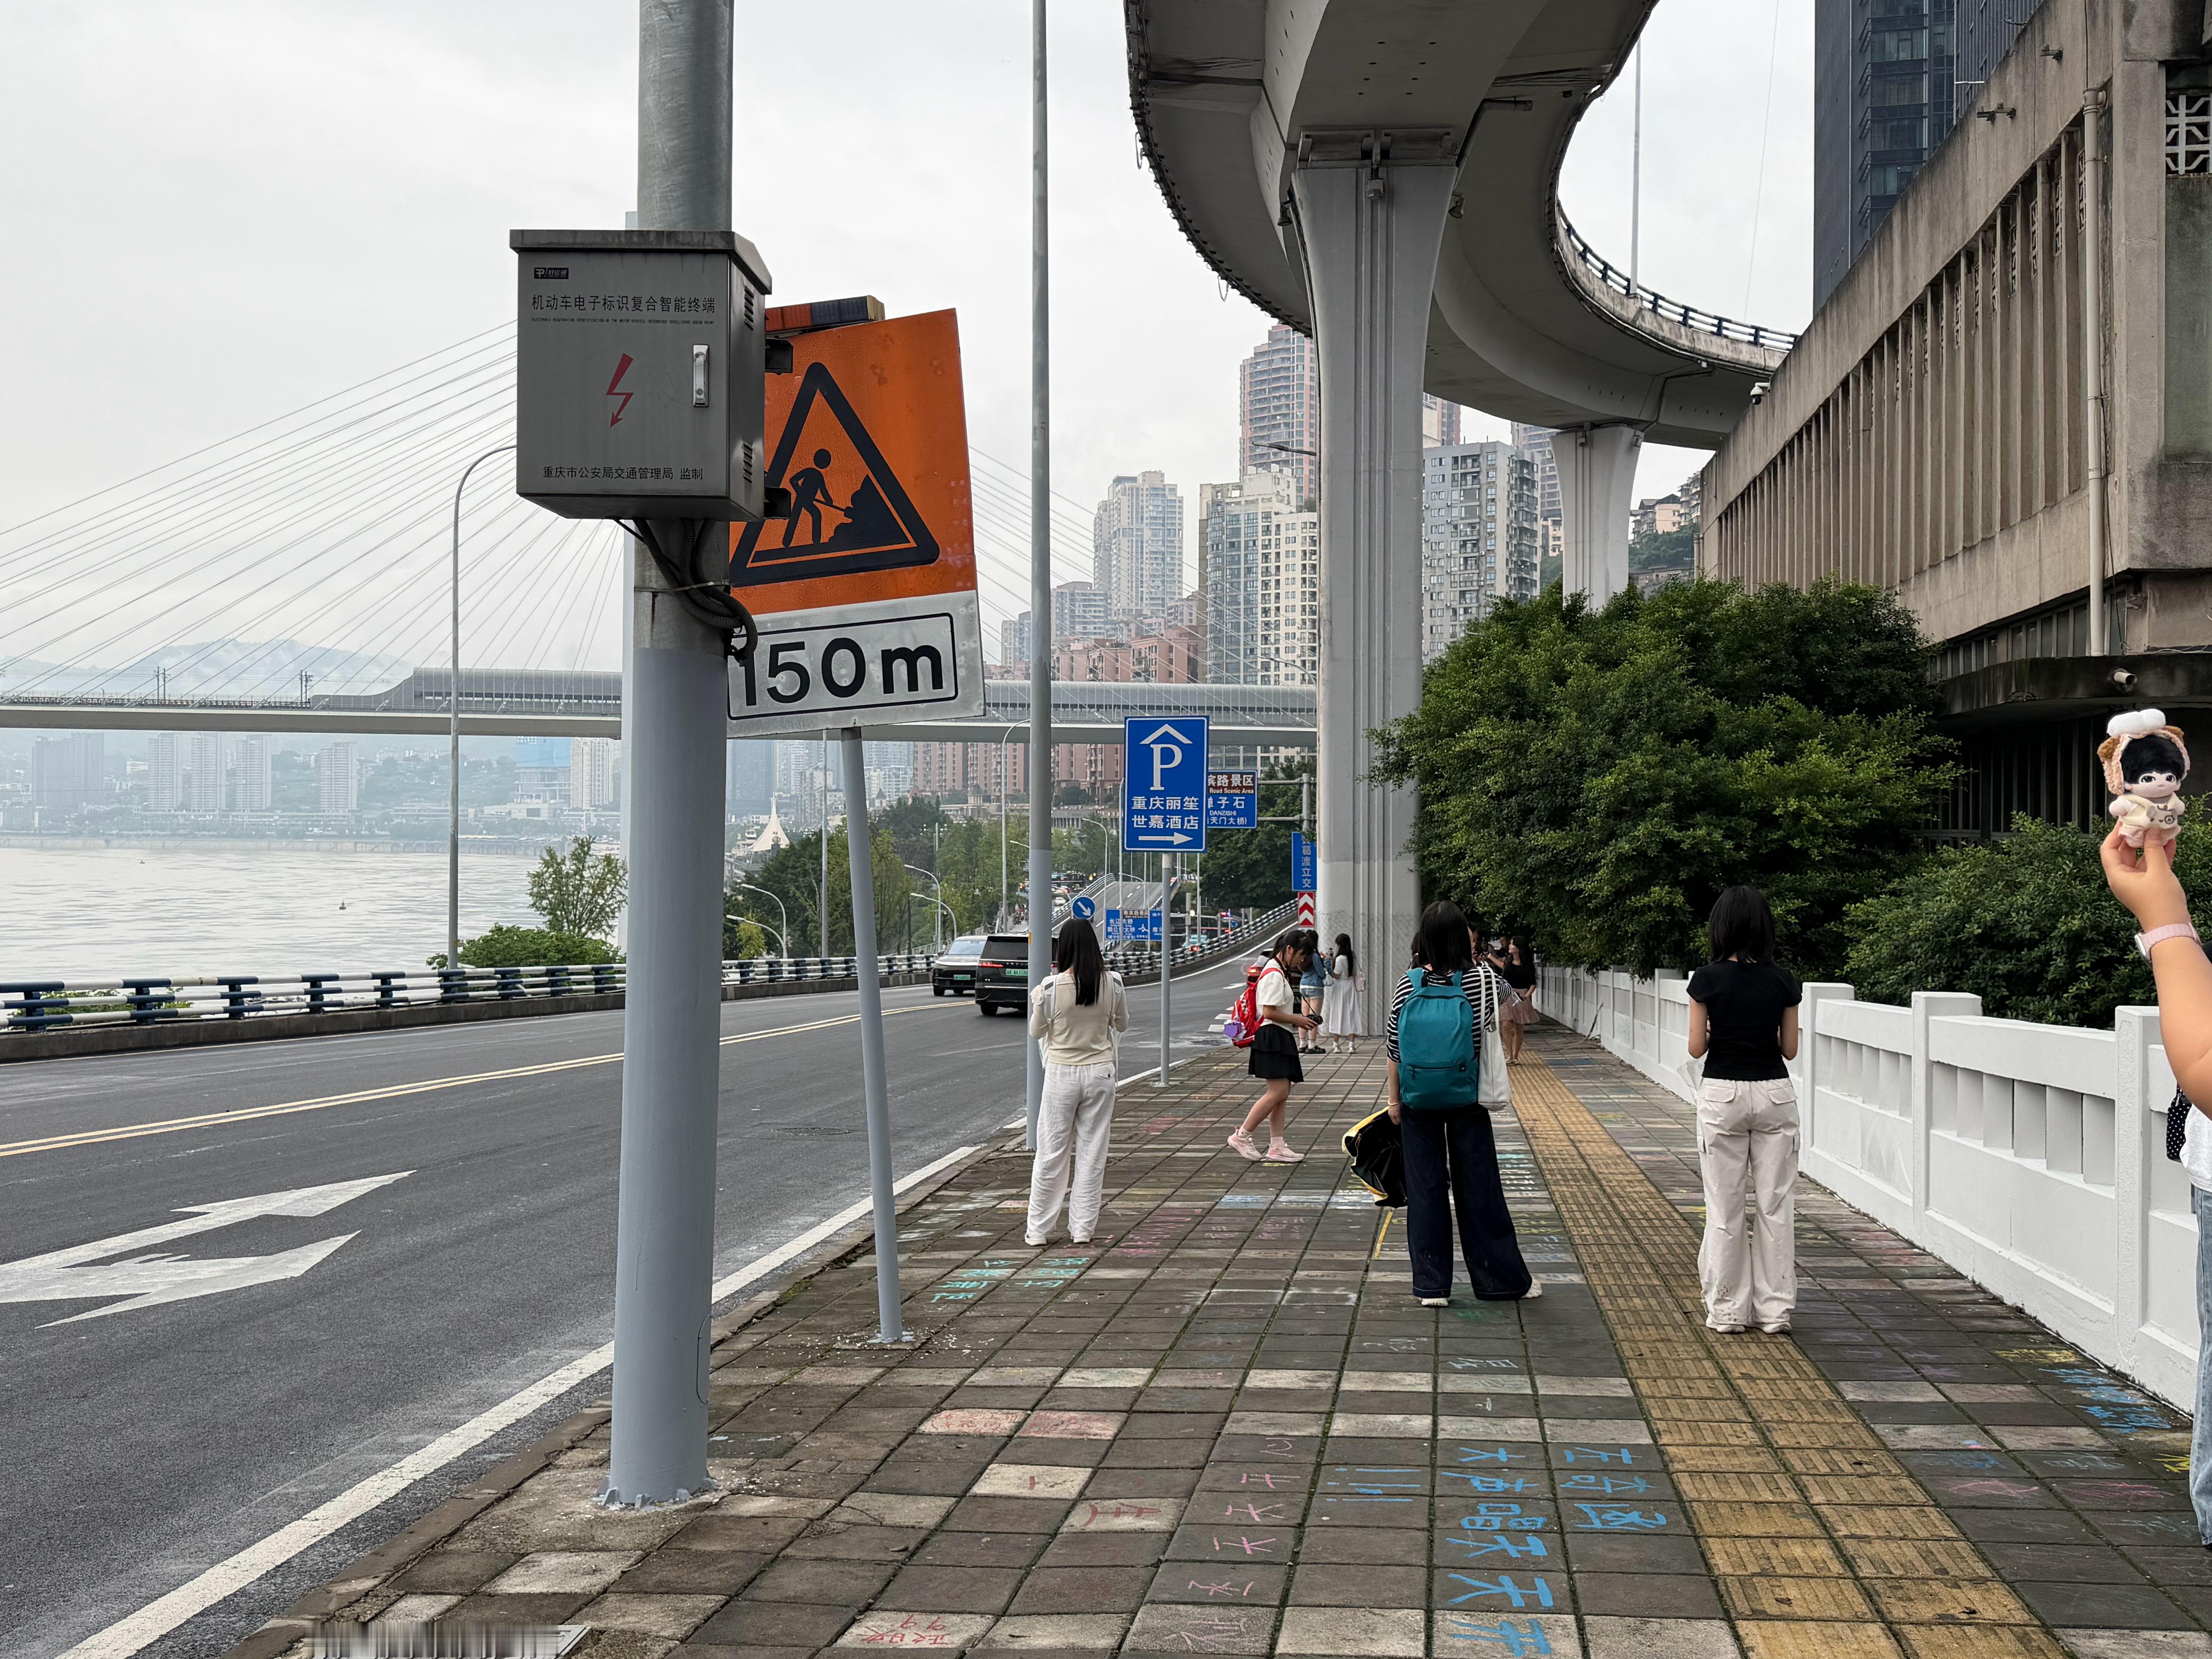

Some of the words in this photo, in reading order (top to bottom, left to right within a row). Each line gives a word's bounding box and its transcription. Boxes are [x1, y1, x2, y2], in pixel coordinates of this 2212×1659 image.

[531, 294, 715, 313] 机动车电子标识复合智能终端
[543, 466, 673, 480] 重庆市公安局交通管理局
[680, 468, 703, 480] 监制
[738, 637, 943, 706] 150m
[1150, 744, 1183, 790] P
[1132, 796, 1199, 810] 重庆丽笙
[1132, 815, 1199, 830] 世嘉酒店
